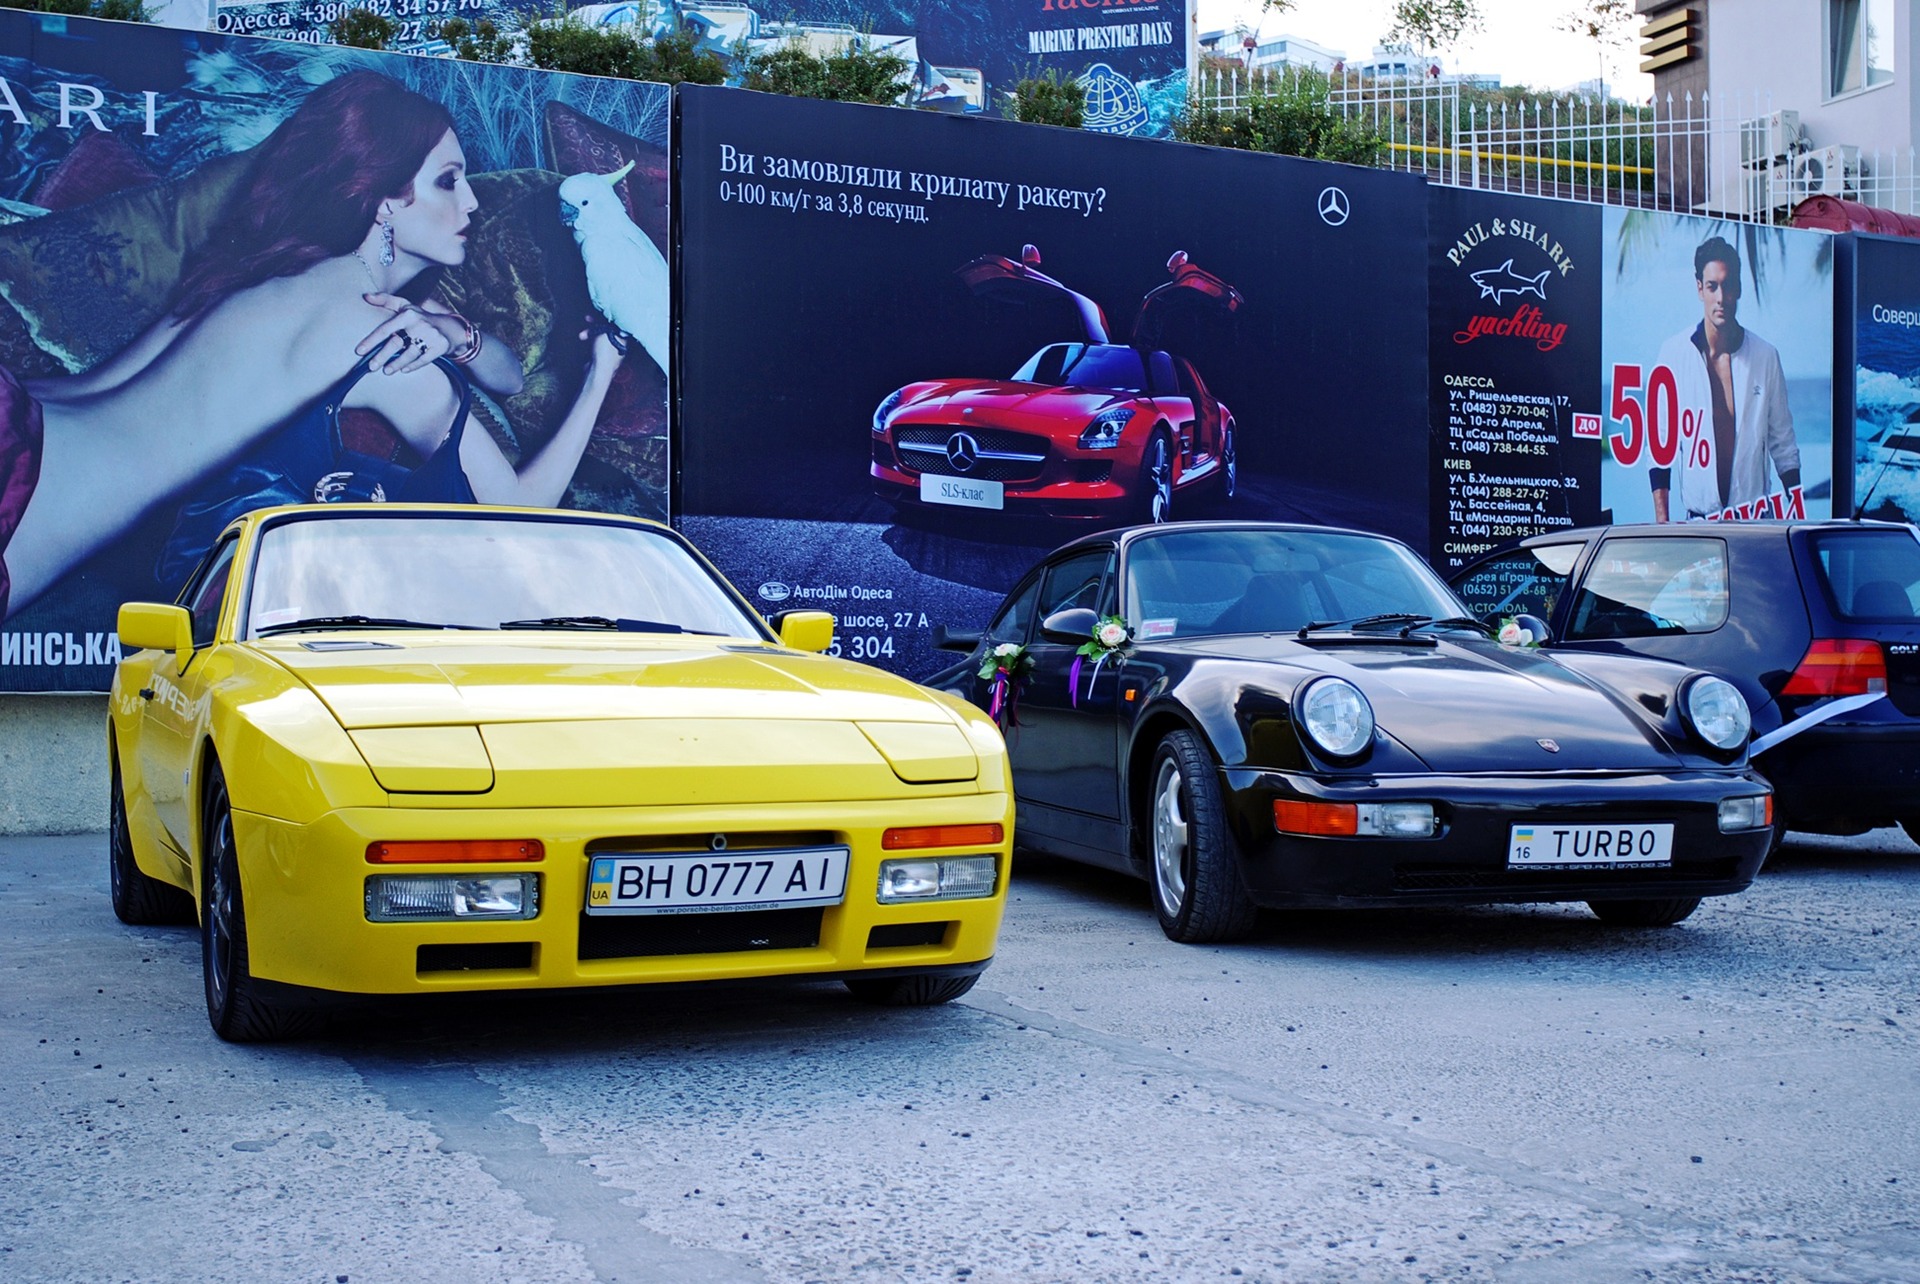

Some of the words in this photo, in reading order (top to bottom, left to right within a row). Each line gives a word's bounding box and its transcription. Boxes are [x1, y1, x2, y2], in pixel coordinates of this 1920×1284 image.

[216, 10, 291, 34] Одесса
[396, 0, 421, 16] 34
[1028, 29, 1075, 54] MARINE
[1078, 23, 1140, 51] PRESTIGE
[1141, 21, 1173, 46] DAYS
[719, 143, 755, 175] Ви
[762, 154, 902, 191] замовляли
[909, 170, 1010, 208] крилату
[1017, 184, 1107, 217] ракету?
[719, 180, 766, 206] 0-100
[770, 188, 811, 213] км/г
[815, 194, 834, 211] за
[838, 192, 863, 217] 3,8
[868, 198, 930, 224] секунд.
[1446, 222, 1490, 267] PAUL
[1491, 217, 1506, 237] &
[1509, 218, 1576, 278] SHARK
[1453, 303, 1569, 352] yachting
[1443, 374, 1495, 389] ОДЕССА
[1449, 389, 1466, 401] ул.
[1469, 389, 1553, 406] Ришельевская,
[1556, 395, 1572, 408] 17,
[1449, 403, 1459, 412] т.
[1462, 402, 1497, 416] (0482)
[1499, 404, 1550, 418] 37-70-04;
[1449, 416, 1466, 426] пл.
[1470, 415, 1498, 427] 10-го
[1501, 417, 1546, 431] Апреля,
[1449, 427, 1464, 439] ТЦ
[1466, 428, 1504, 441] «Сады
[1449, 442, 1459, 451] т.
[1461, 441, 1490, 454] (048)
[1493, 442, 1549, 456] 738-44-55.
[1443, 458, 1472, 470] КИЕВ
[1449, 473, 1466, 485] ул.
[1468, 472, 1562, 488] Б.Хмельницкого,
[1564, 477, 1580, 489] 32,
[940, 482, 985, 501] SLS-клас
[1449, 487, 1459, 496] т.
[1461, 485, 1490, 499] (044)
[1449, 500, 1466, 510] ул.
[1468, 499, 1534, 513] Бассейная,
[1536, 502, 1546, 513] 4,
[1449, 511, 1464, 524] ТЦ
[1466, 513, 1532, 526] «Мандарин
[1449, 526, 1459, 535] т.
[1461, 525, 1490, 538] (044)
[793, 585, 848, 600] АвтоДім
[851, 586, 893, 601] Одеса
[844, 614, 889, 630] шосе,
[893, 613, 914, 628] 27
[851, 636, 896, 659] 304
[1553, 829, 1656, 858] TURBO
[1515, 847, 1531, 859] 16
[617, 864, 674, 899] BH
[686, 860, 774, 897] 0777
[784, 857, 829, 893] AI
[591, 890, 609, 900] UA
[656, 902, 779, 915] www.porsche-berlin-potsdam.de
